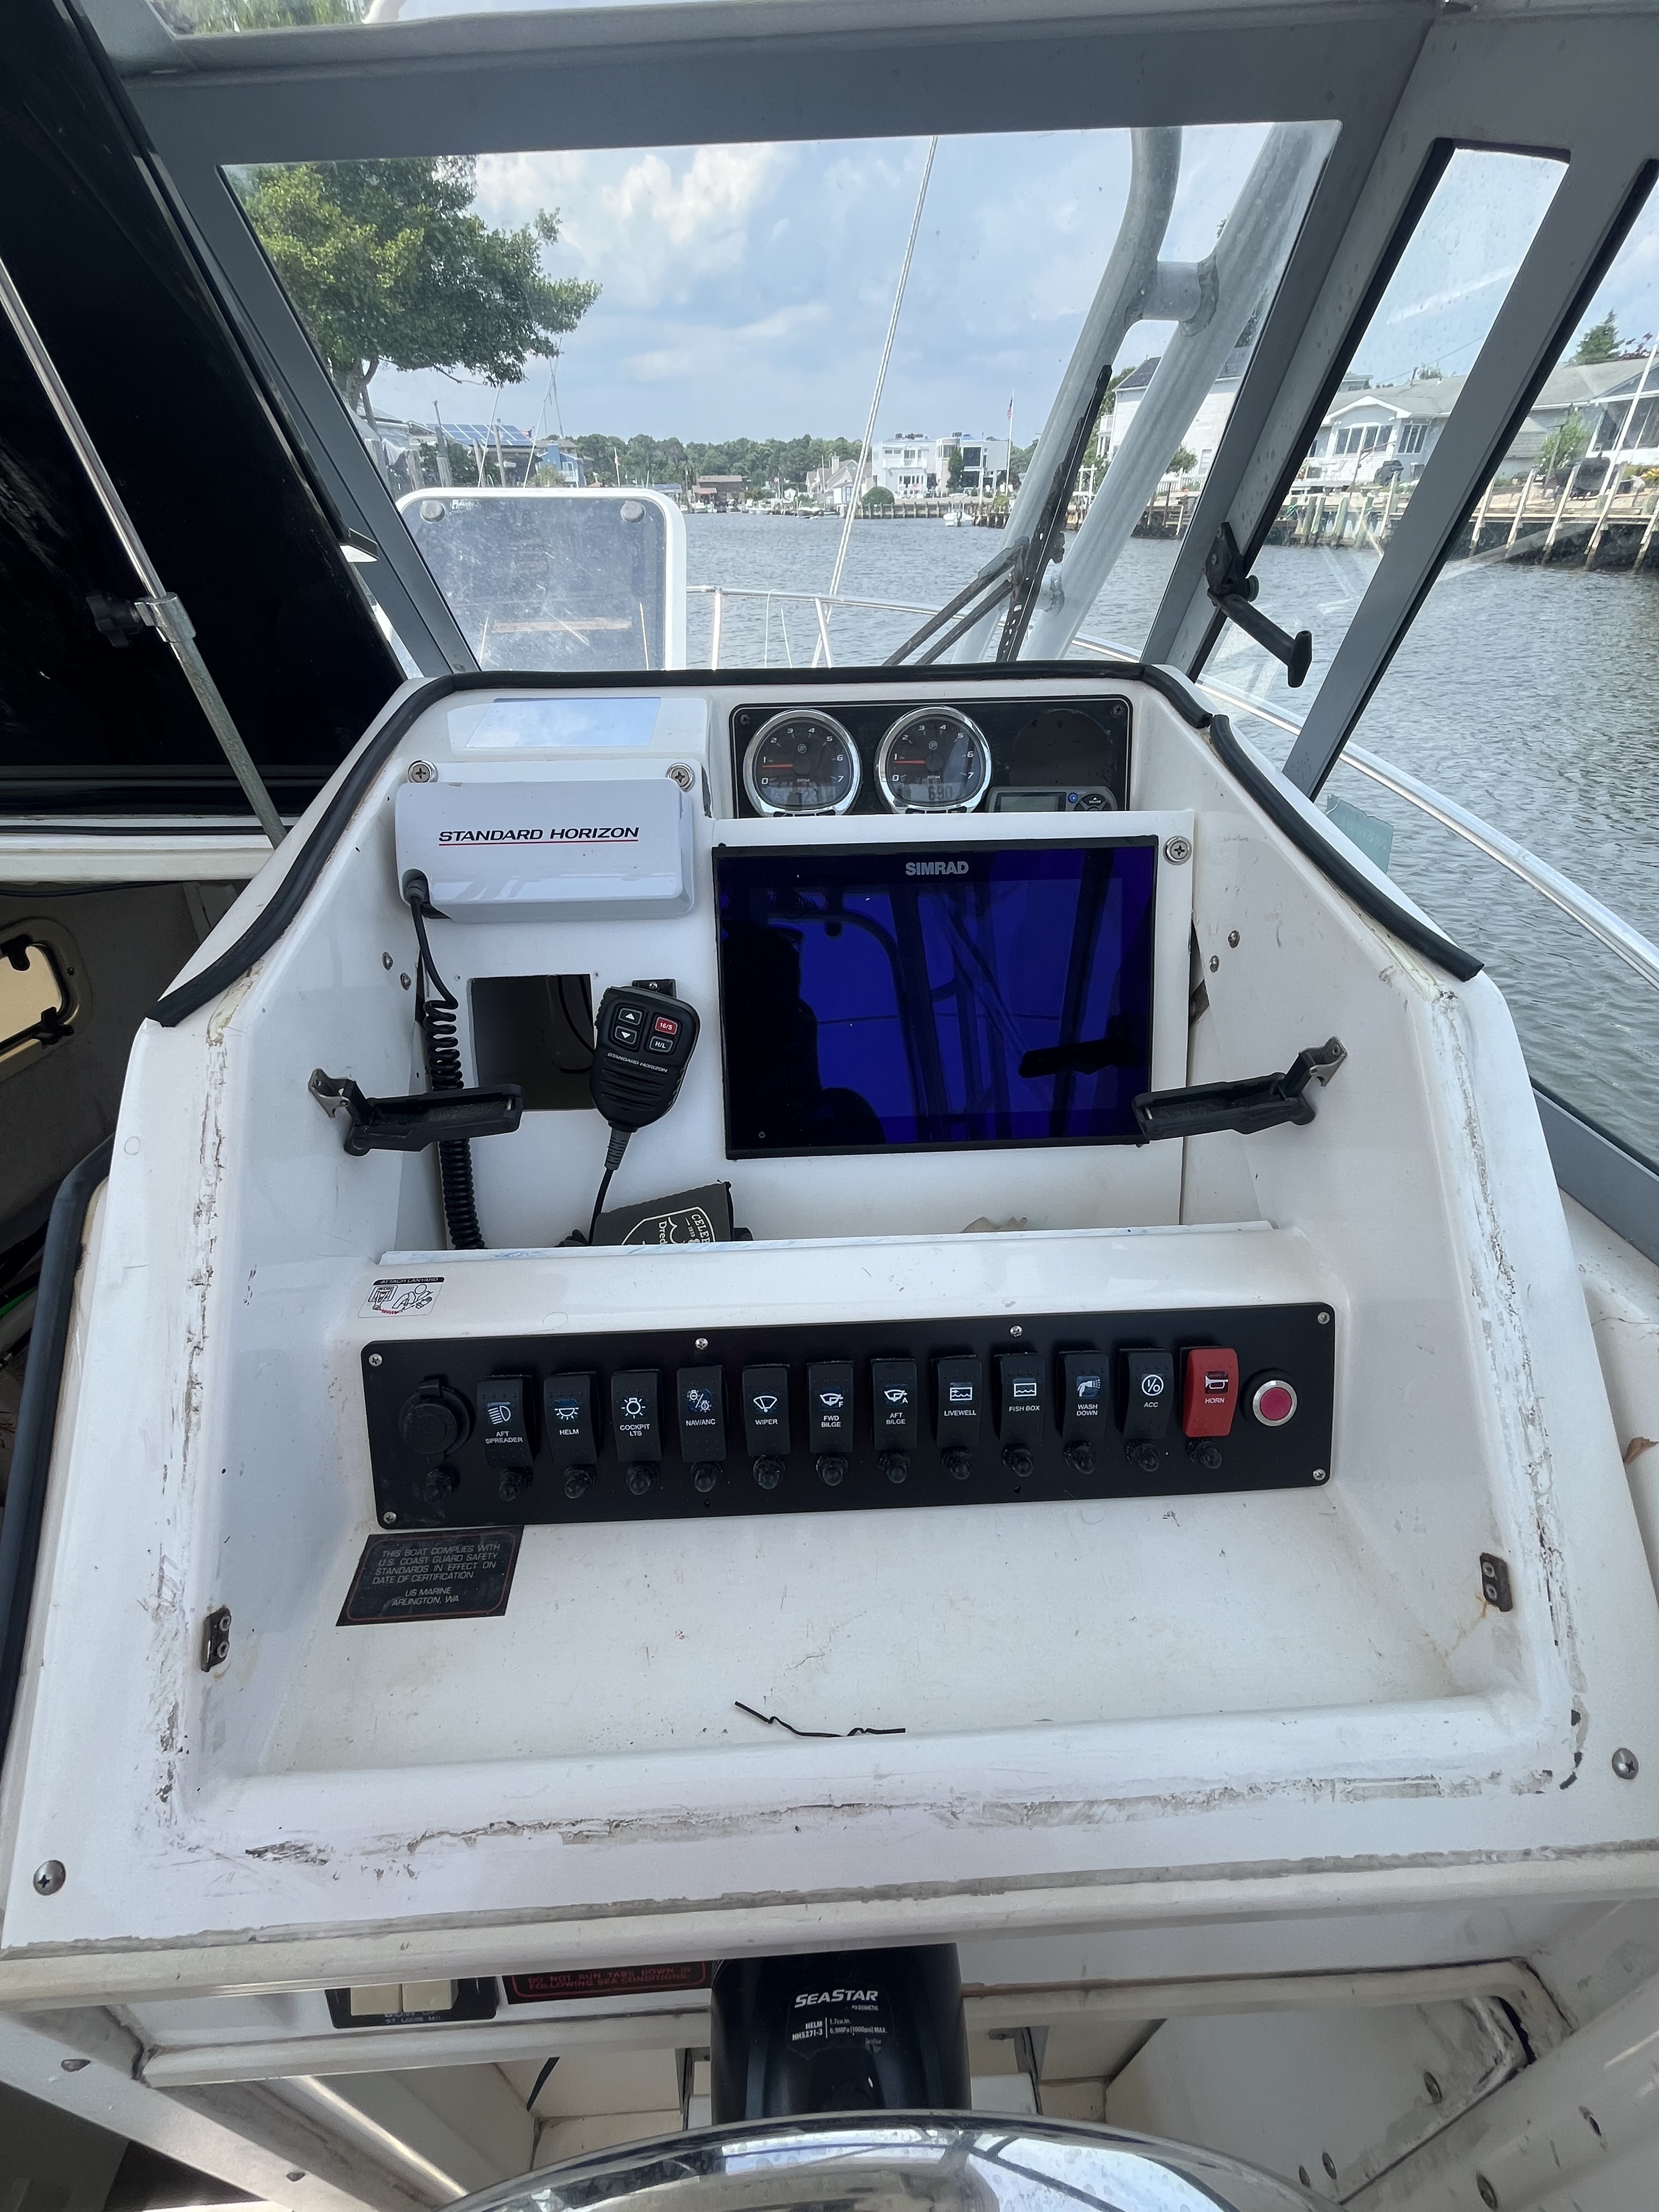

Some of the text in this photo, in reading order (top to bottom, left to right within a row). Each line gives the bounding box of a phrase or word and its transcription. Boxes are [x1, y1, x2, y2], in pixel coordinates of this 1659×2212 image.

[439, 827, 639, 842] STANDARD HORIZON
[905, 861, 969, 876] SIMRAD
[660, 1022, 673, 1030] 16/S
[607, 1052, 668, 1073] STANDARD HORIZON
[382, 1544, 500, 1558] THIS BOAT COMPLIES WITH
[378, 1553, 499, 1567] U.S. COAST GUARD SAFETY
[375, 1565, 429, 1576] STANDARDS
[447, 1562, 478, 1571] EFFECT
[482, 1561, 496, 1569] ON
[372, 1571, 475, 1585] DATE OF CERTIFICATION.
[405, 1587, 452, 1597] US MARINE
[445, 1595, 460, 1604] WA
[529, 1980, 594, 1990] FOLLOWING
[805, 2020, 823, 2029] HELM
